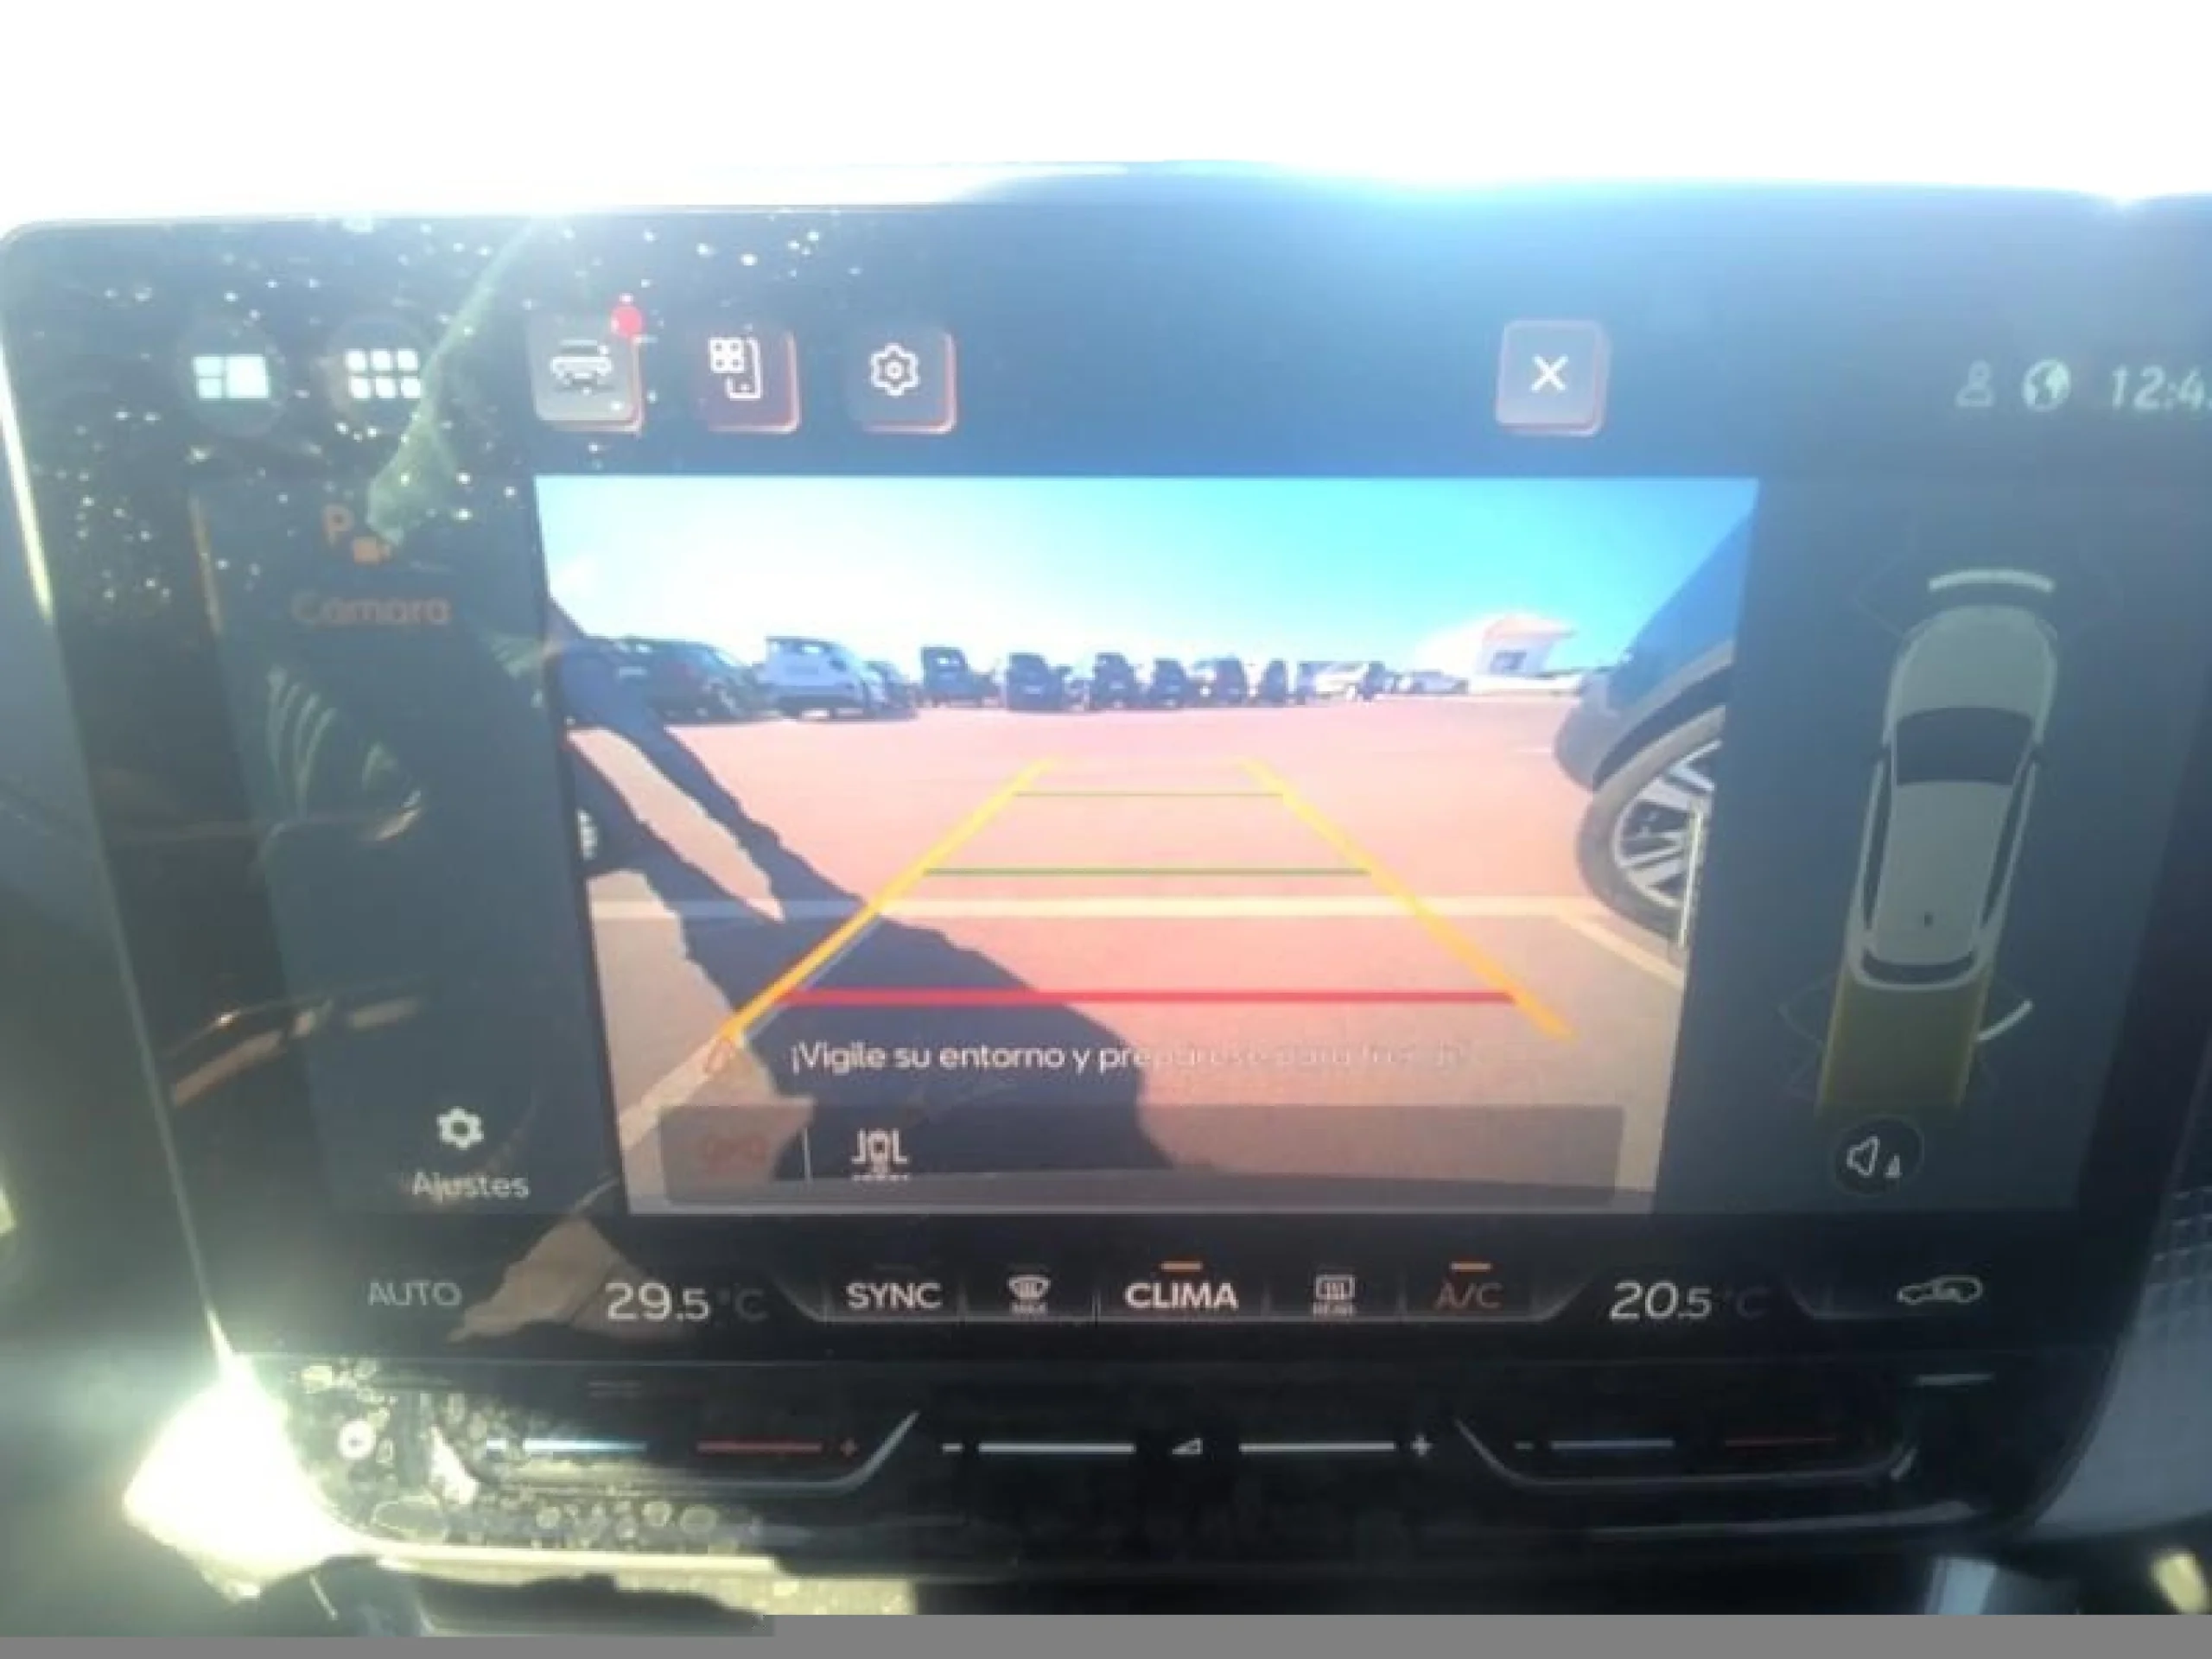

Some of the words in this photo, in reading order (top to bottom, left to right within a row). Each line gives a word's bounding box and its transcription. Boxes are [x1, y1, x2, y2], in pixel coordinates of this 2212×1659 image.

[2111, 363, 2212, 411] 12:4
[893, 1047, 931, 1070] su
[938, 1044, 1065, 1070] entorno
[1071, 1047, 1090, 1077] y
[411, 1170, 531, 1204] Ajustes
[366, 1281, 463, 1307] AUTO
[605, 1281, 712, 1322] 29.5
[845, 1281, 944, 1311] SYNC
[1124, 1281, 1240, 1310] CLIMA
[1434, 1281, 1504, 1311] A/C
[1609, 1281, 1713, 1321] 20.5
